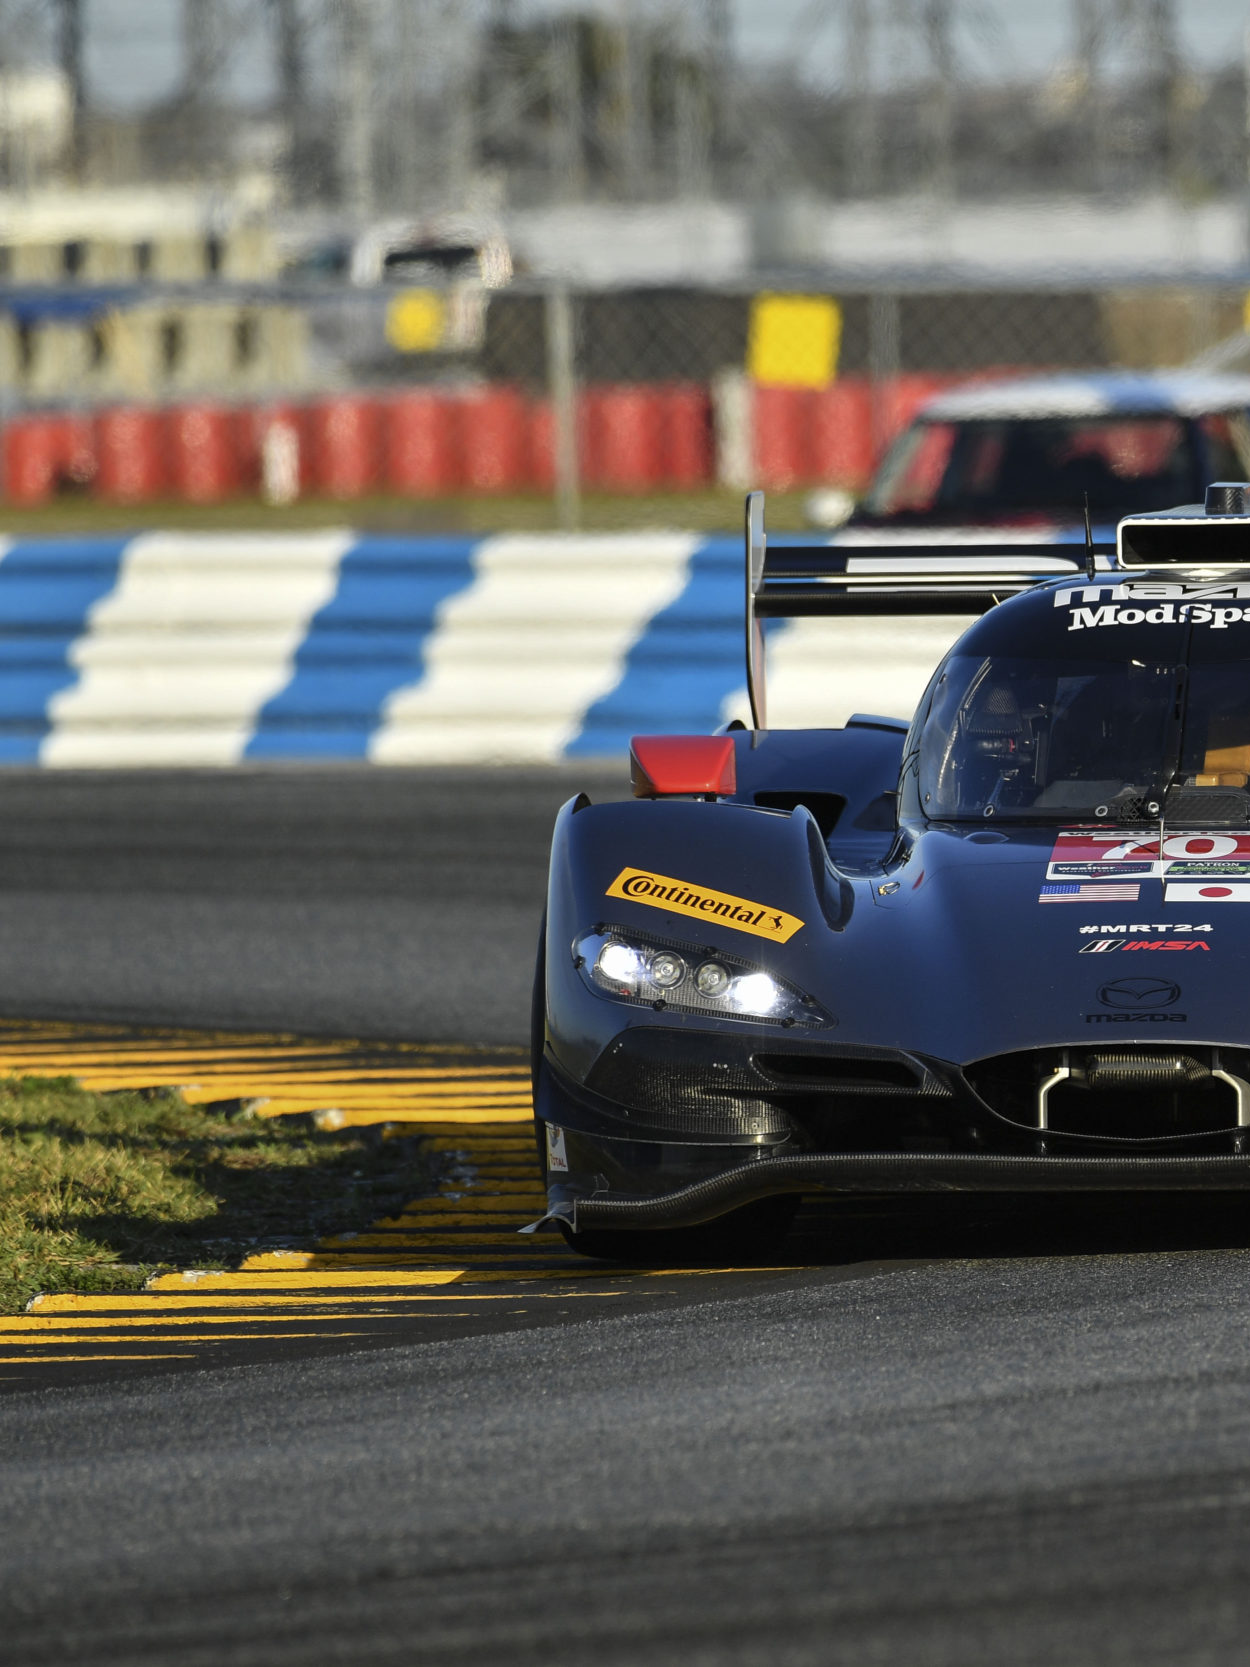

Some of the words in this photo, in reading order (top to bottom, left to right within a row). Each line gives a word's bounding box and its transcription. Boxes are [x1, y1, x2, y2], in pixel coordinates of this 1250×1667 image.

[1092, 835, 1238, 859] 70
[622, 875, 766, 926] Continental
[1079, 924, 1214, 934] #MRT24
[1121, 941, 1211, 951] IMSA
